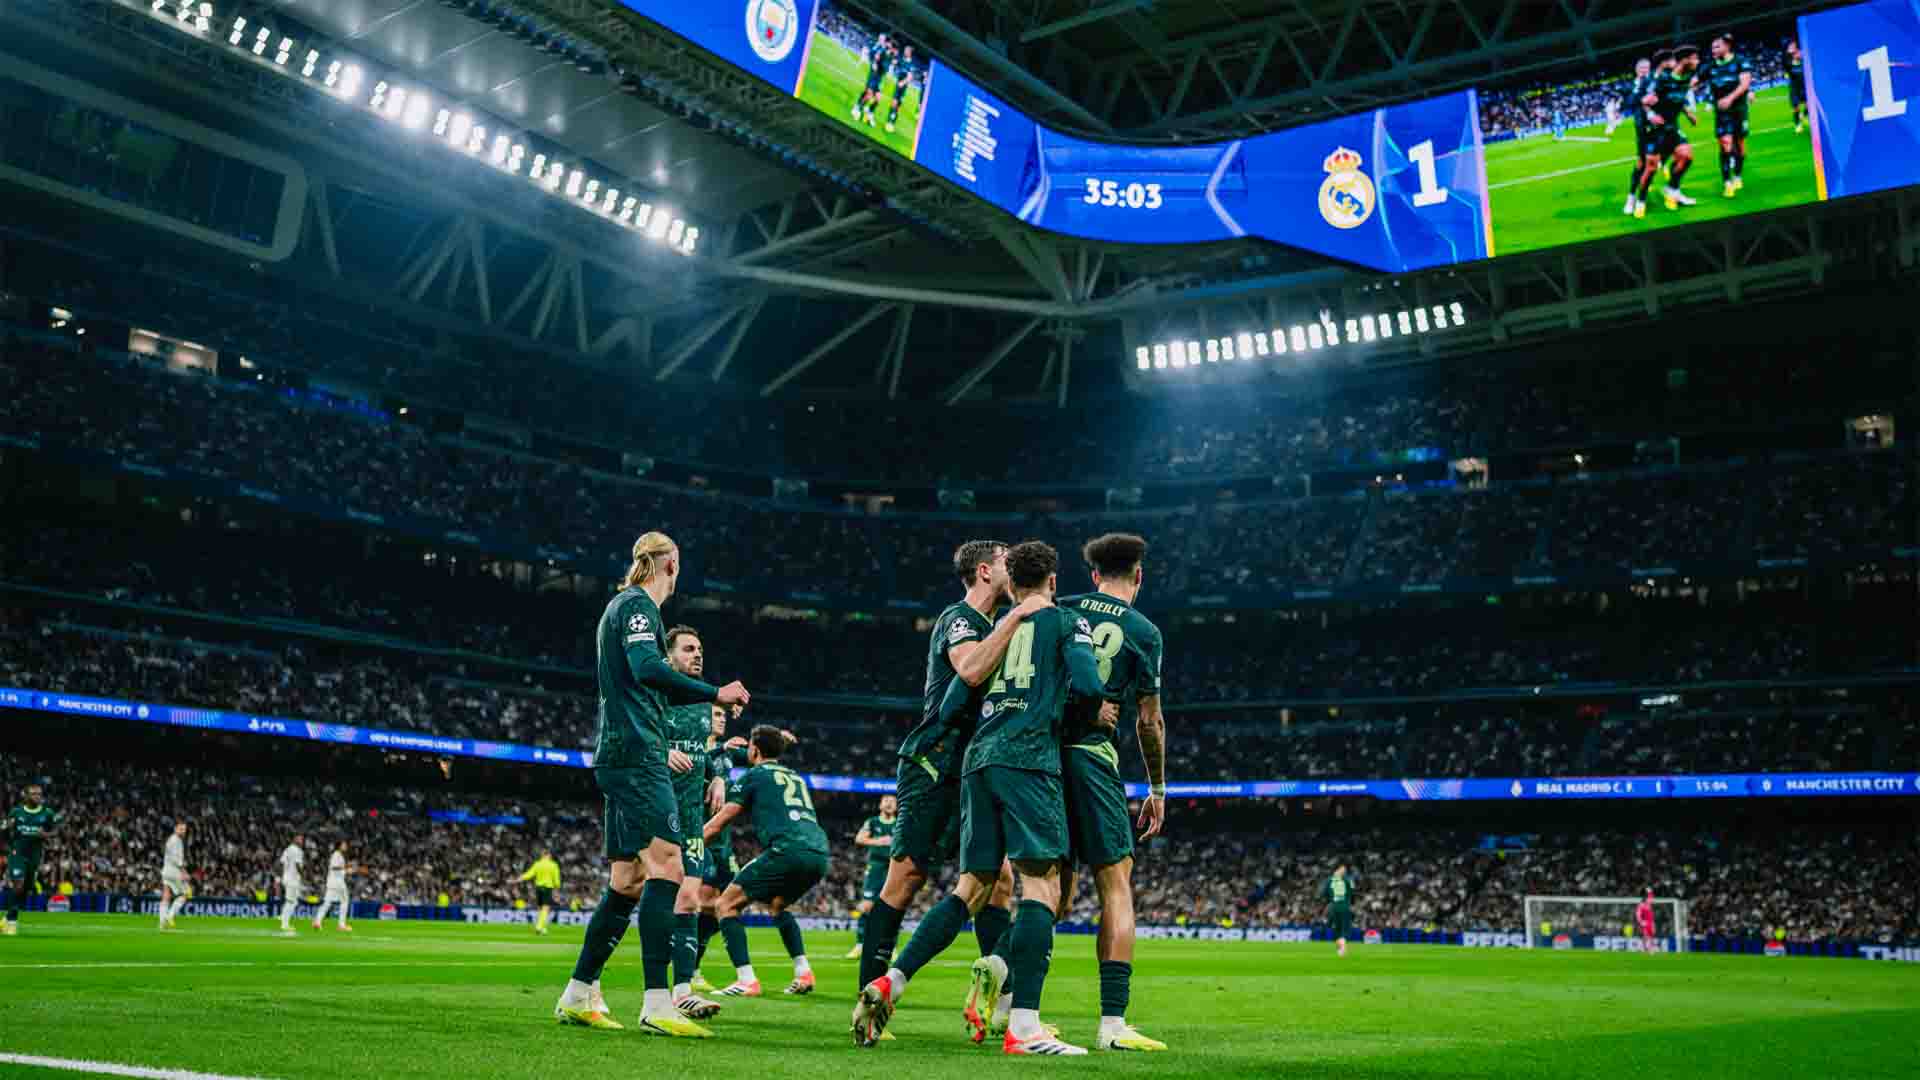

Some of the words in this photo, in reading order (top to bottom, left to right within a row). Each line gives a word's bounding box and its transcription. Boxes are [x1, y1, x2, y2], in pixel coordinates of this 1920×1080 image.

[1857, 45, 1907, 121] 1
[1408, 139, 1448, 207] 1
[1083, 177, 1162, 209] 35:03
[1080, 598, 1127, 616] O'REILLY
[984, 621, 1035, 696] 4
[666, 739, 705, 752] TIHA
[774, 771, 815, 811] 27
[1536, 782, 1562, 794] REAL
[1566, 782, 1611, 793] MADRID
[1785, 779, 1871, 791] MANCHESTER
[1874, 778, 1904, 790] CITY
[686, 838, 704, 861] 20
[184, 902, 269, 920] CHAMPIONS
[1199, 928, 1243, 941] FOR
[1245, 929, 1311, 942] MORE
